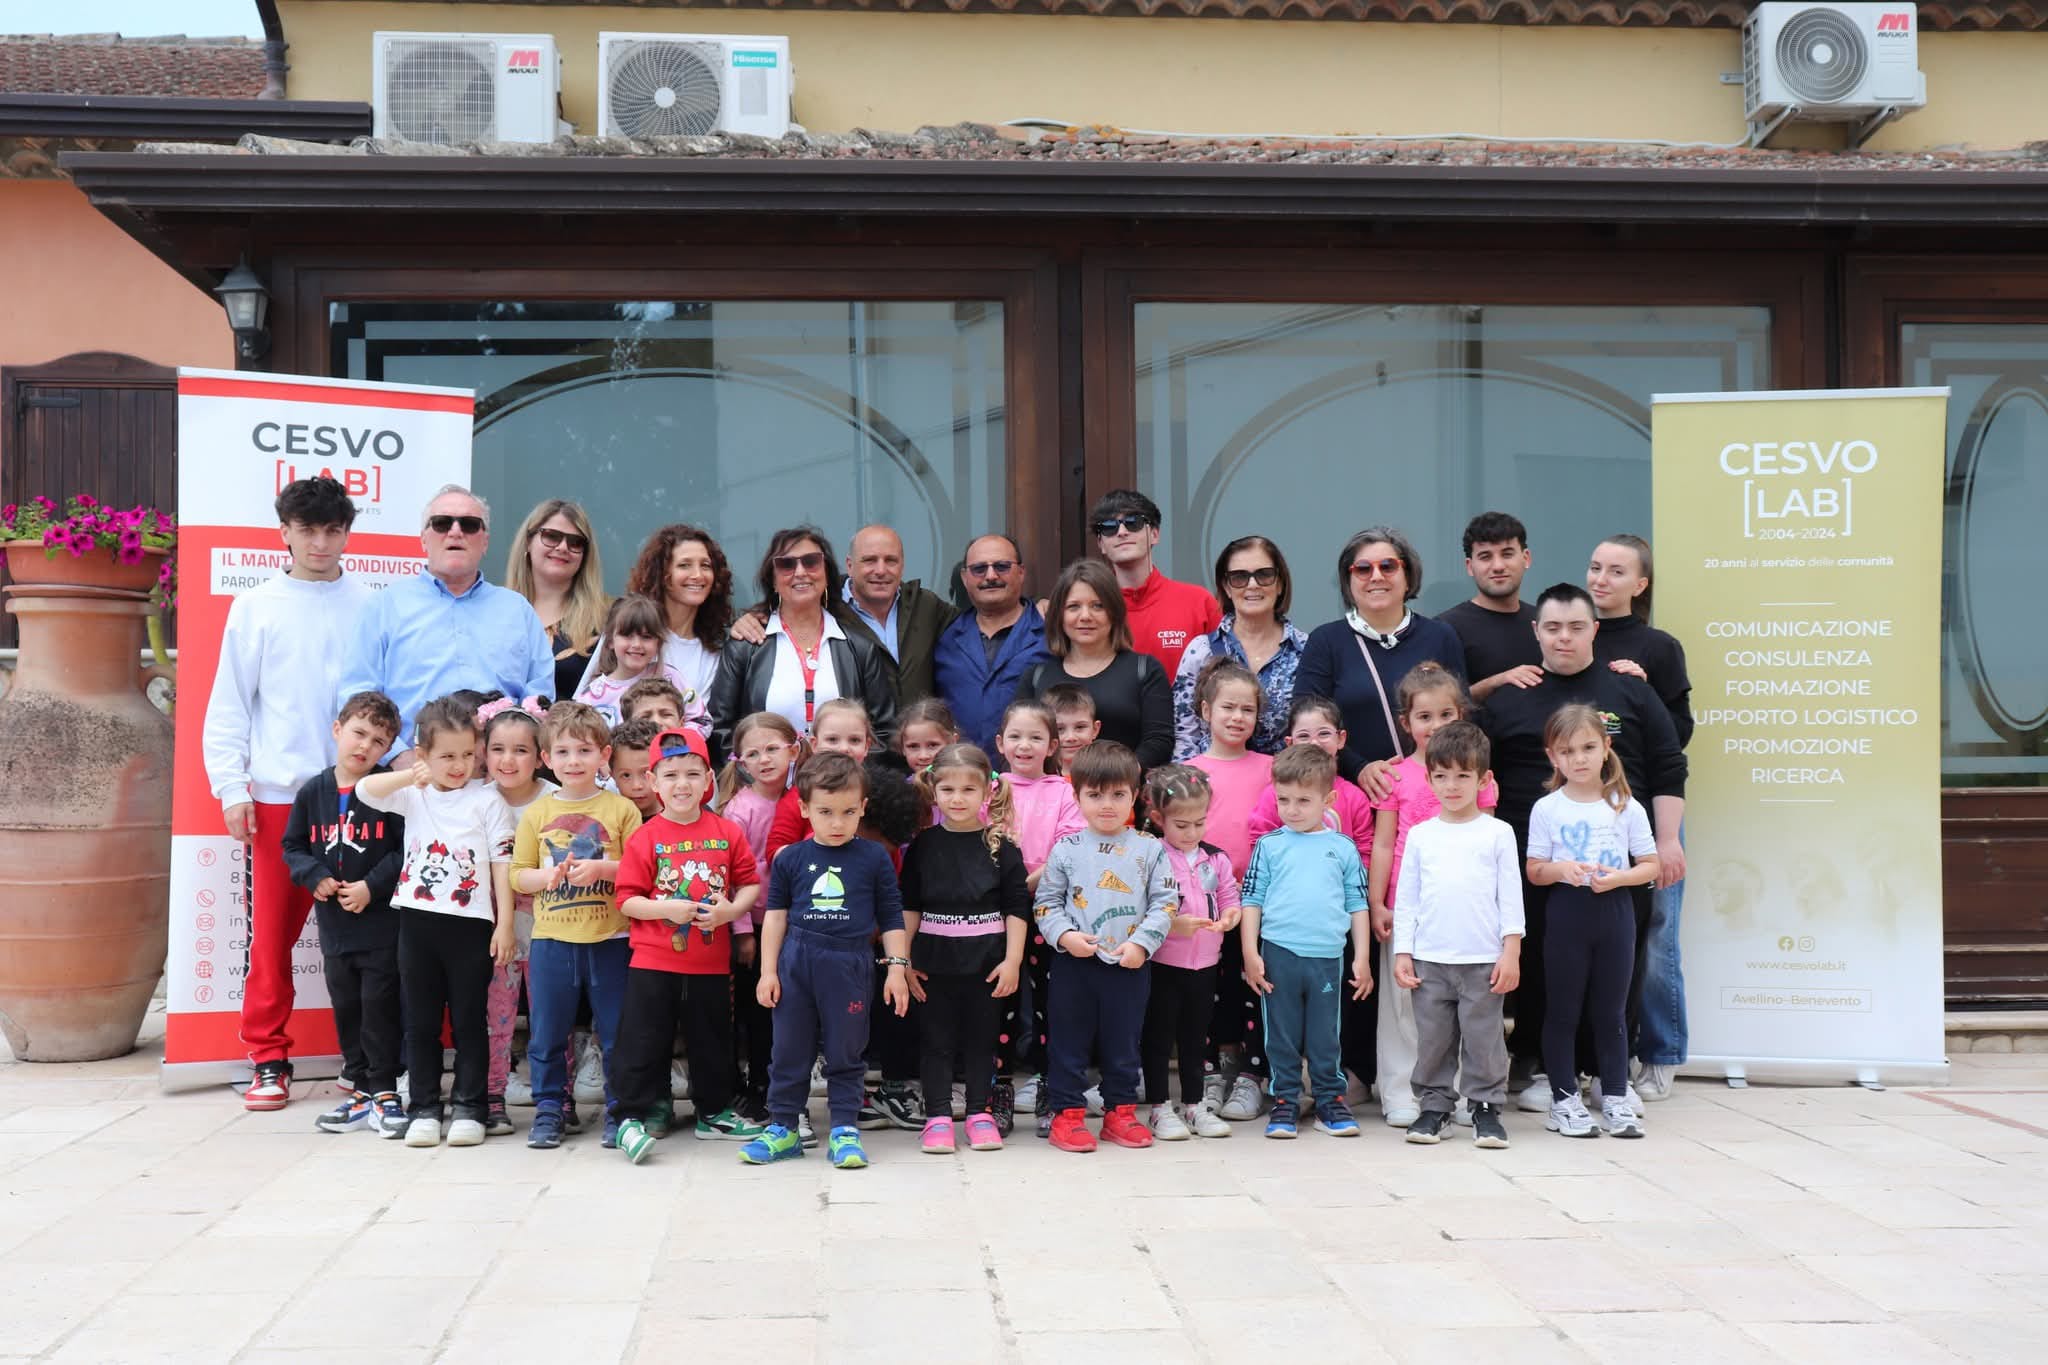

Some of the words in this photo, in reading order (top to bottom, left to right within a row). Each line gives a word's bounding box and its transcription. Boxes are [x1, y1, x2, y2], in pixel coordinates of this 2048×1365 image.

[733, 53, 776, 64] Hisense
[252, 421, 405, 461] CESVO
[1719, 440, 1878, 476] CESVO
[1744, 478, 1852, 538] [LAB]
[222, 552, 236, 566] IL
[344, 558, 423, 575] ONDIVISO
[1704, 558, 1719, 569] 20
[1721, 557, 1747, 568] anni
[1761, 556, 1805, 568] servizio
[1157, 630, 1187, 638] CESVO
[1706, 620, 1893, 638] COMUNICAZIONE
[1724, 649, 1873, 667] CONSULENZA
[1726, 679, 1872, 696] FORMAZIONE
[1804, 708, 1918, 725] LOGISTICO
[1724, 738, 1873, 755] PROMOZIONE
[1751, 767, 1845, 784] RICERCA
[655, 841, 693, 854] SUPER
[693, 839, 729, 851] MARIO
